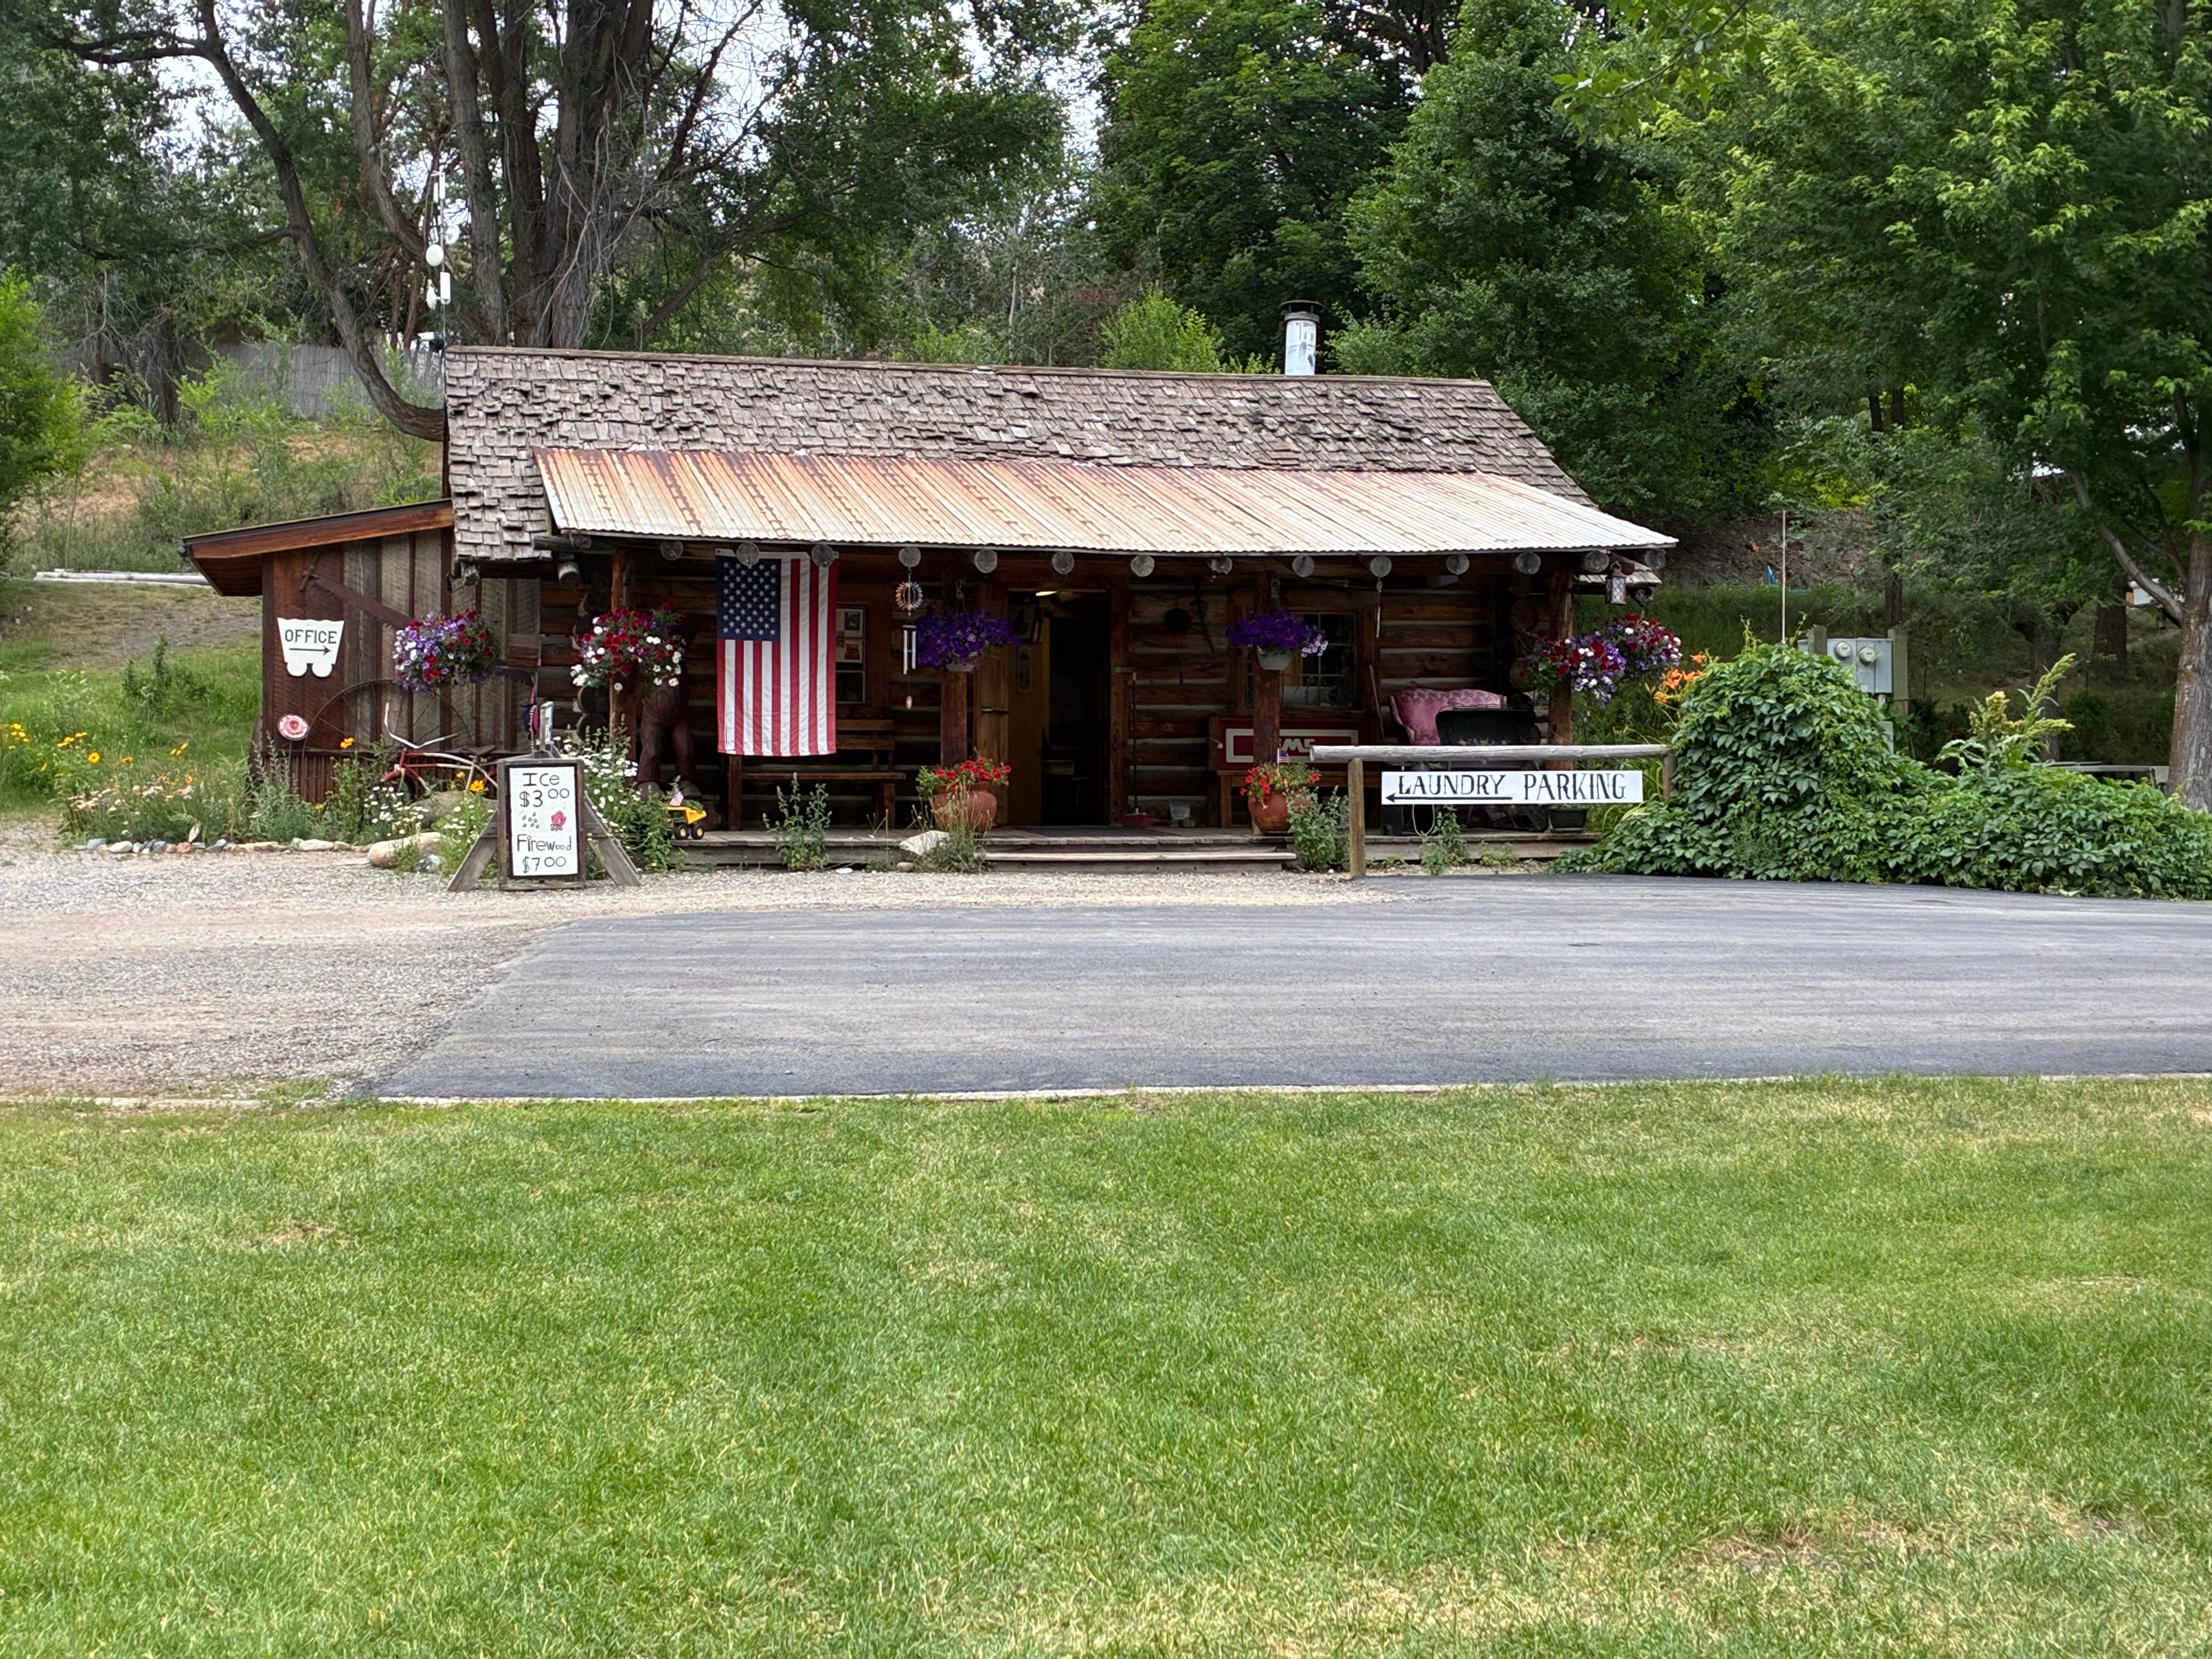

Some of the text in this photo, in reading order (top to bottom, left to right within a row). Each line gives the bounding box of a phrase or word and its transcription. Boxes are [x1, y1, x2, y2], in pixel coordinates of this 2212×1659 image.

[285, 629, 337, 644] OFFICE
[1398, 773, 1627, 800] LAUNDRY PARKING
[517, 834, 572, 851] Firewood
